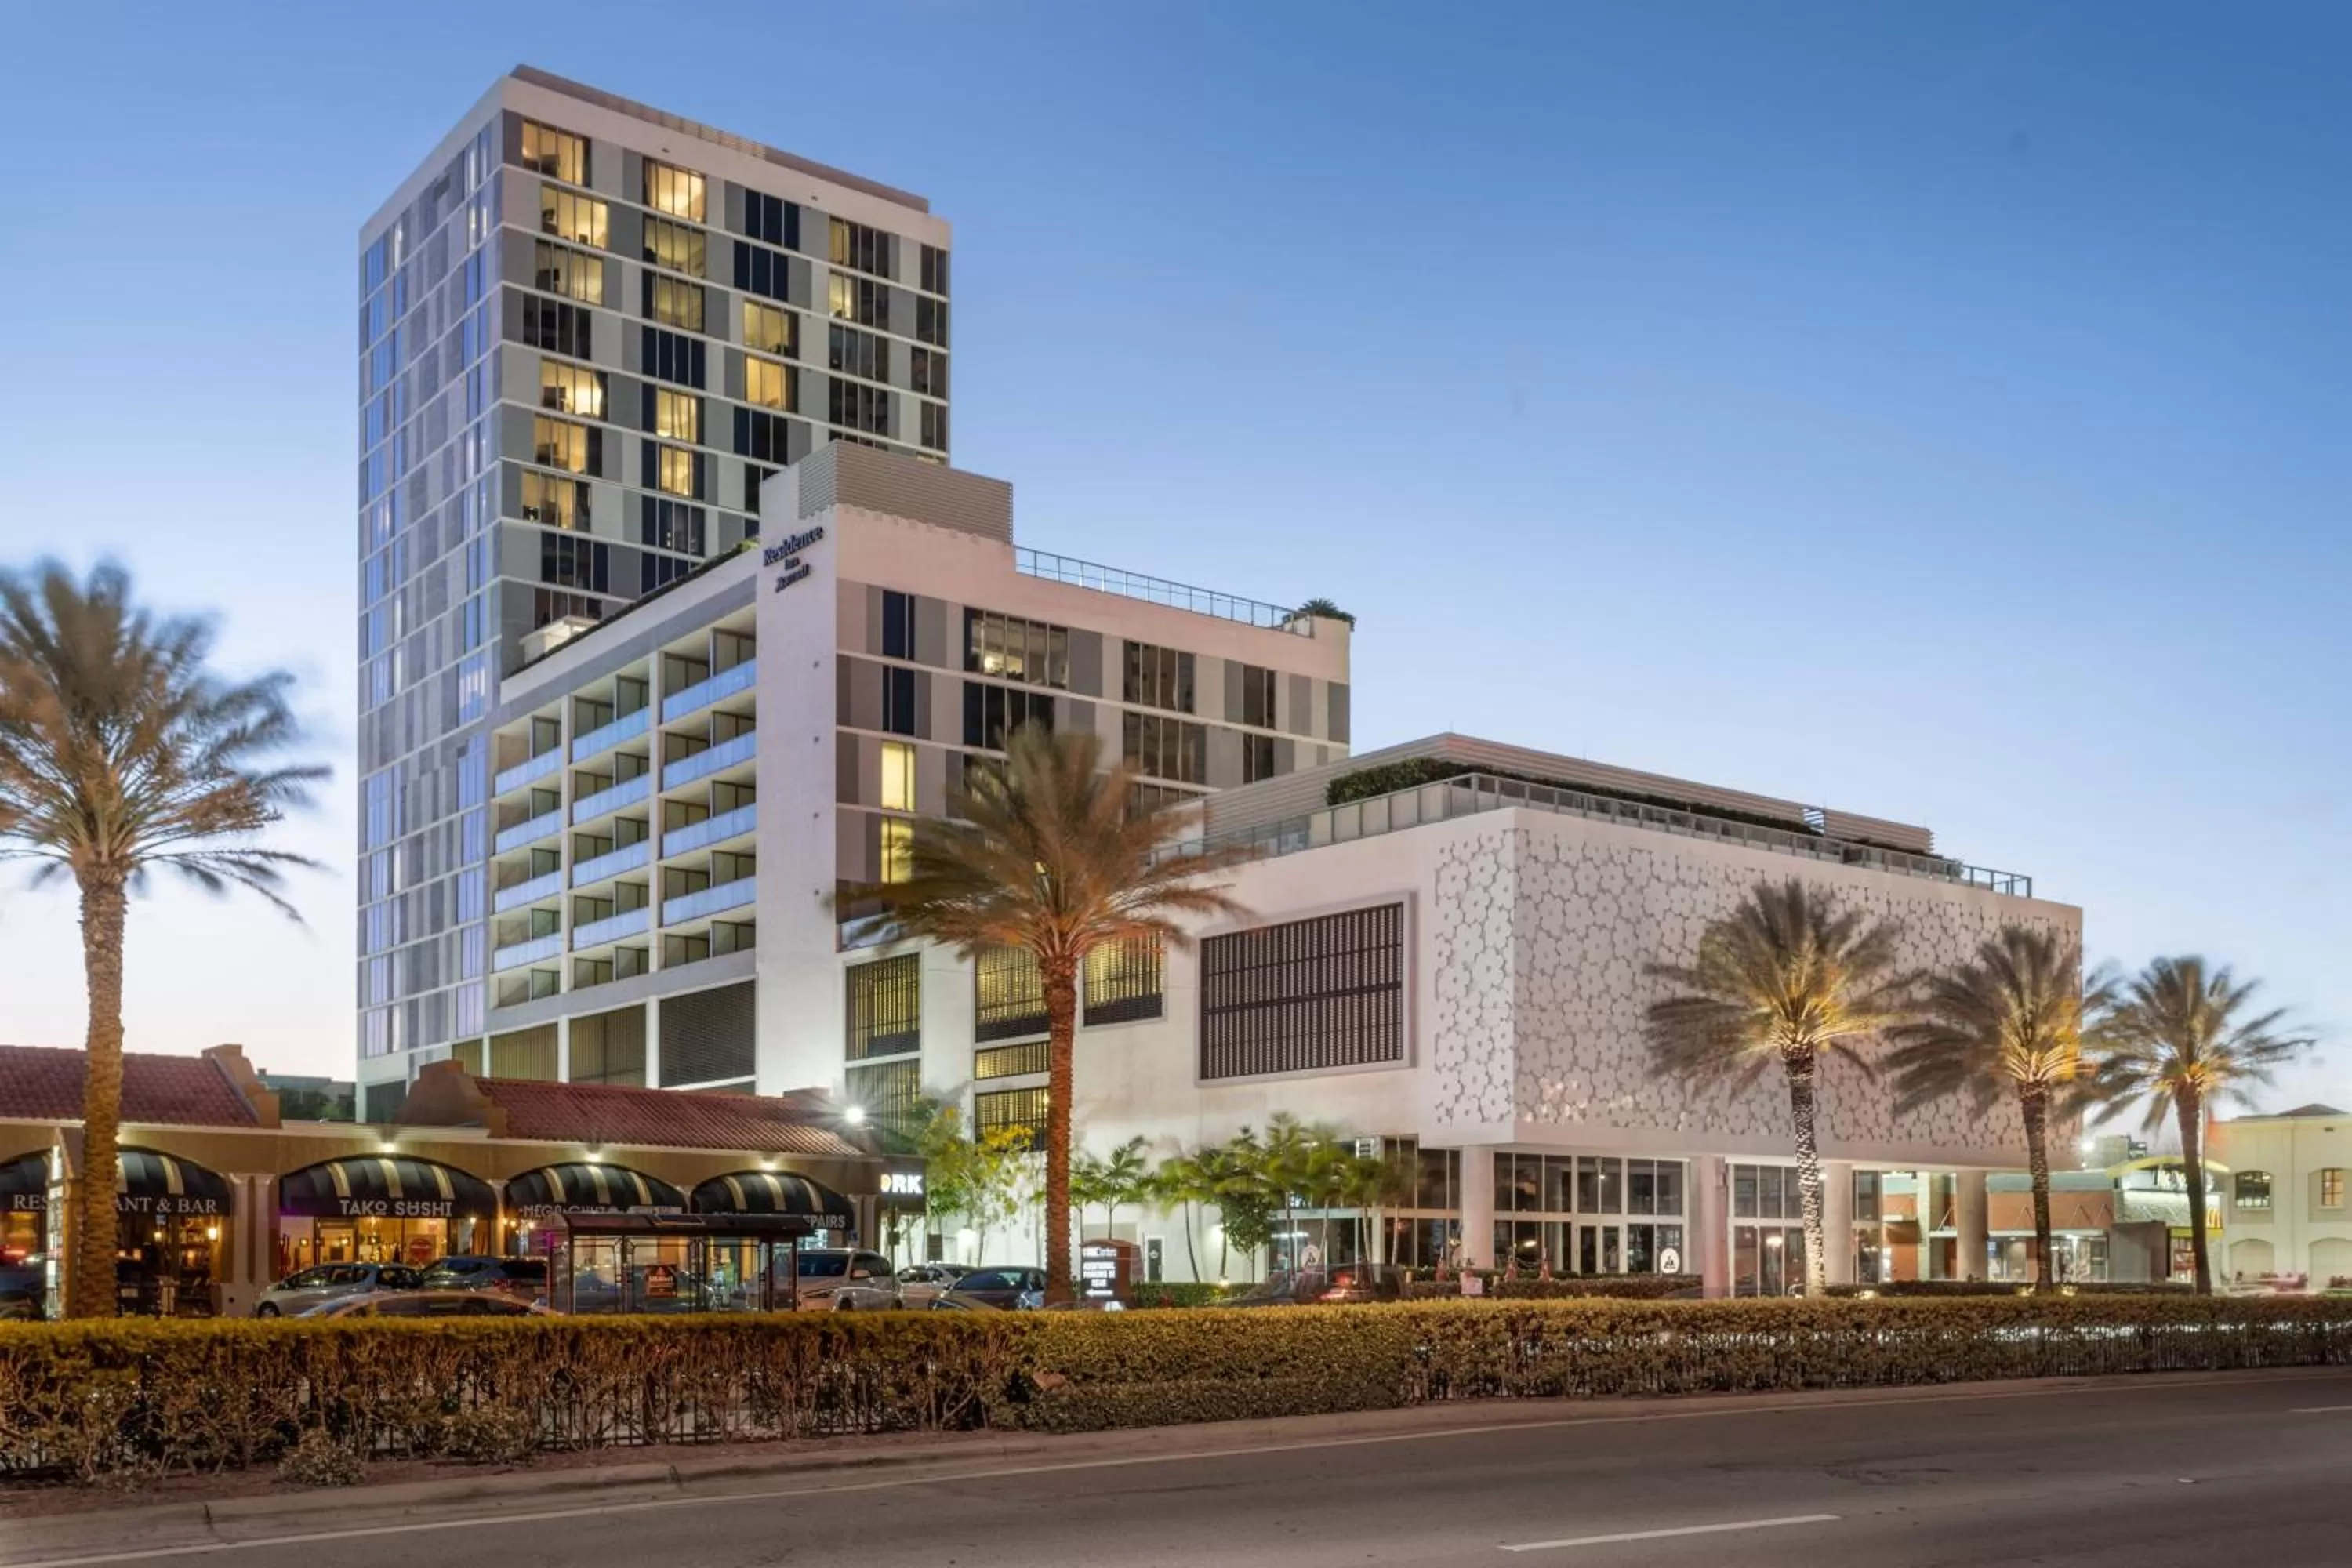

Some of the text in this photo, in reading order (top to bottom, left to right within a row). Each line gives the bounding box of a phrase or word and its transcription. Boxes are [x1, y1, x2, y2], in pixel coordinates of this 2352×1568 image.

[764, 526, 824, 567] Residence
[157, 1197, 171, 1213] &
[178, 1198, 217, 1213] BAR
[339, 1200, 452, 1217] TAKO SUSHI
